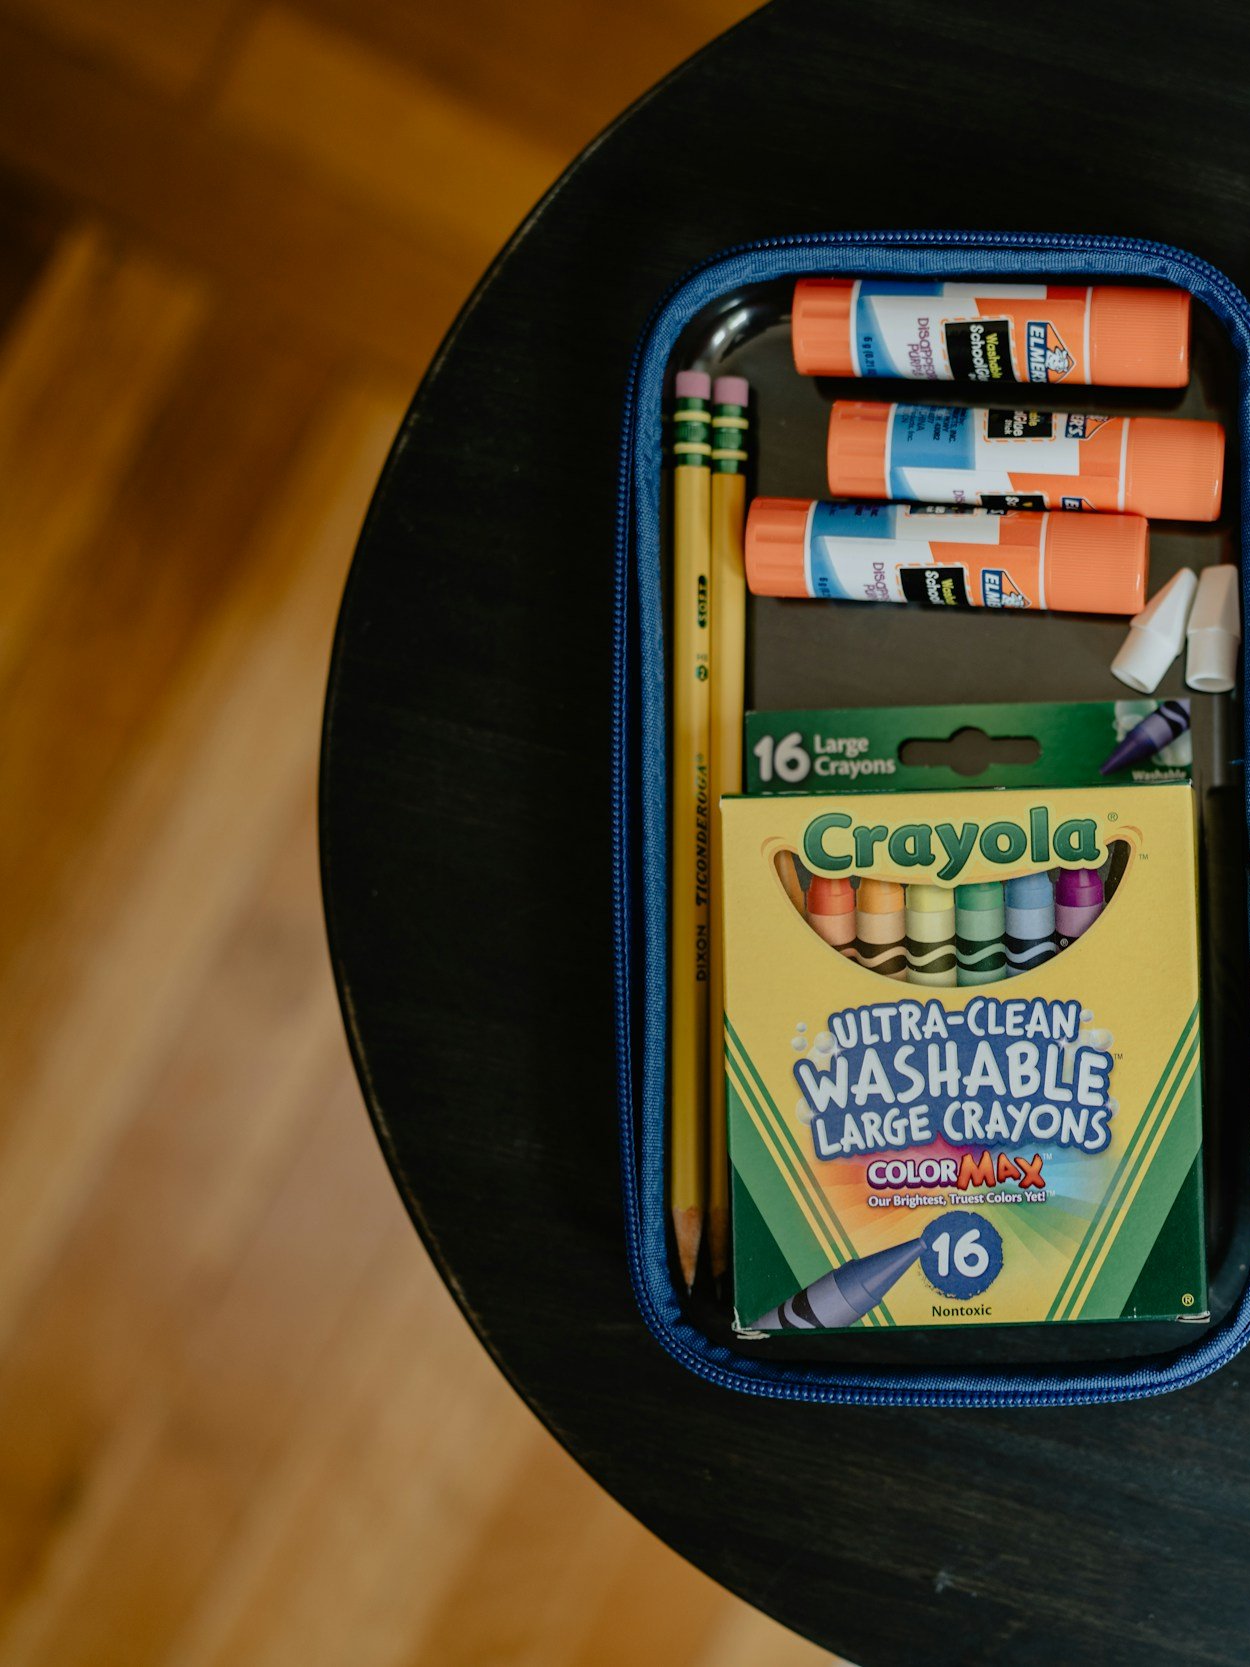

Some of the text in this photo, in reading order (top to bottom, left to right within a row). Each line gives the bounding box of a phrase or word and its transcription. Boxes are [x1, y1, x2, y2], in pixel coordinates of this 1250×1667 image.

[753, 731, 811, 783] 16
[813, 734, 869, 758] Large
[814, 755, 896, 780] Crayons
[803, 806, 1101, 881] Crayola
[695, 763, 708, 981] DIXON TICONDEROGA
[833, 1000, 1081, 1048] ULTRA-CLEAN
[800, 1040, 1109, 1112] WASHABLE
[816, 1101, 1107, 1154] LARGE CRAYONS
[868, 1196, 890, 1207] Our
[893, 1194, 947, 1209] Brightest,
[949, 1193, 984, 1205] Truest
[986, 1191, 1023, 1204] Colors
[1024, 1191, 1046, 1202] Yet!
[931, 1228, 990, 1278] 16
[931, 1304, 993, 1319] Nontoxic
